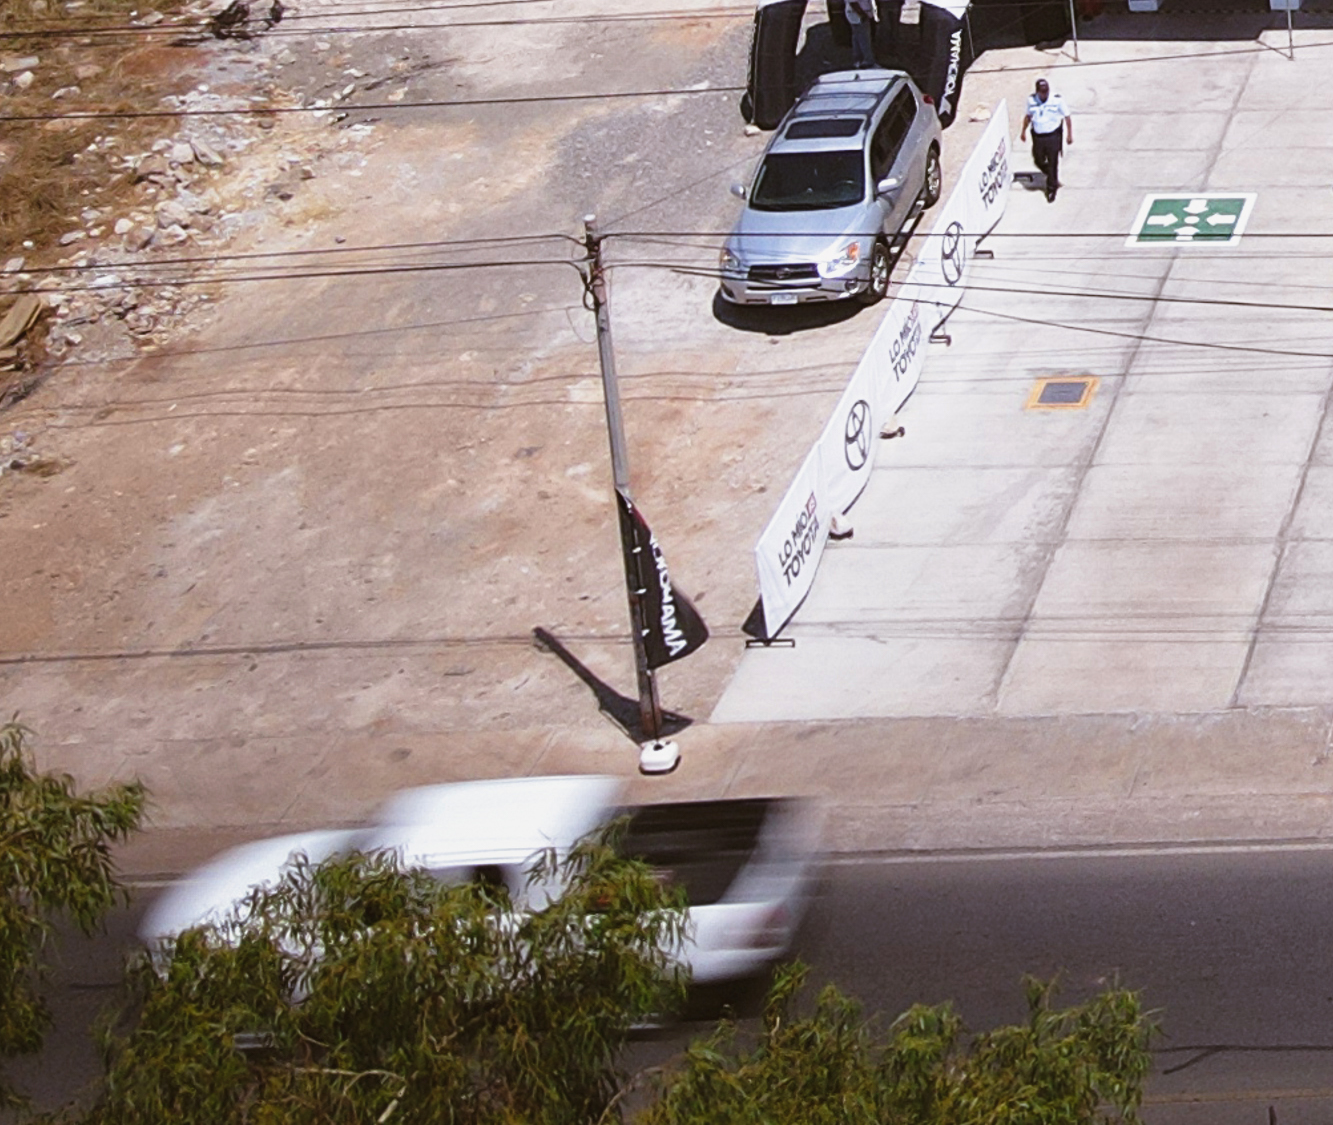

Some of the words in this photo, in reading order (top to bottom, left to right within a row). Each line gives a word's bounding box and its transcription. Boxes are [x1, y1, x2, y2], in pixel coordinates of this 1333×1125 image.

[944, 28, 963, 97] YOKOHAMA
[778, 539, 793, 568] LO
[783, 515, 820, 587] TOYOTA
